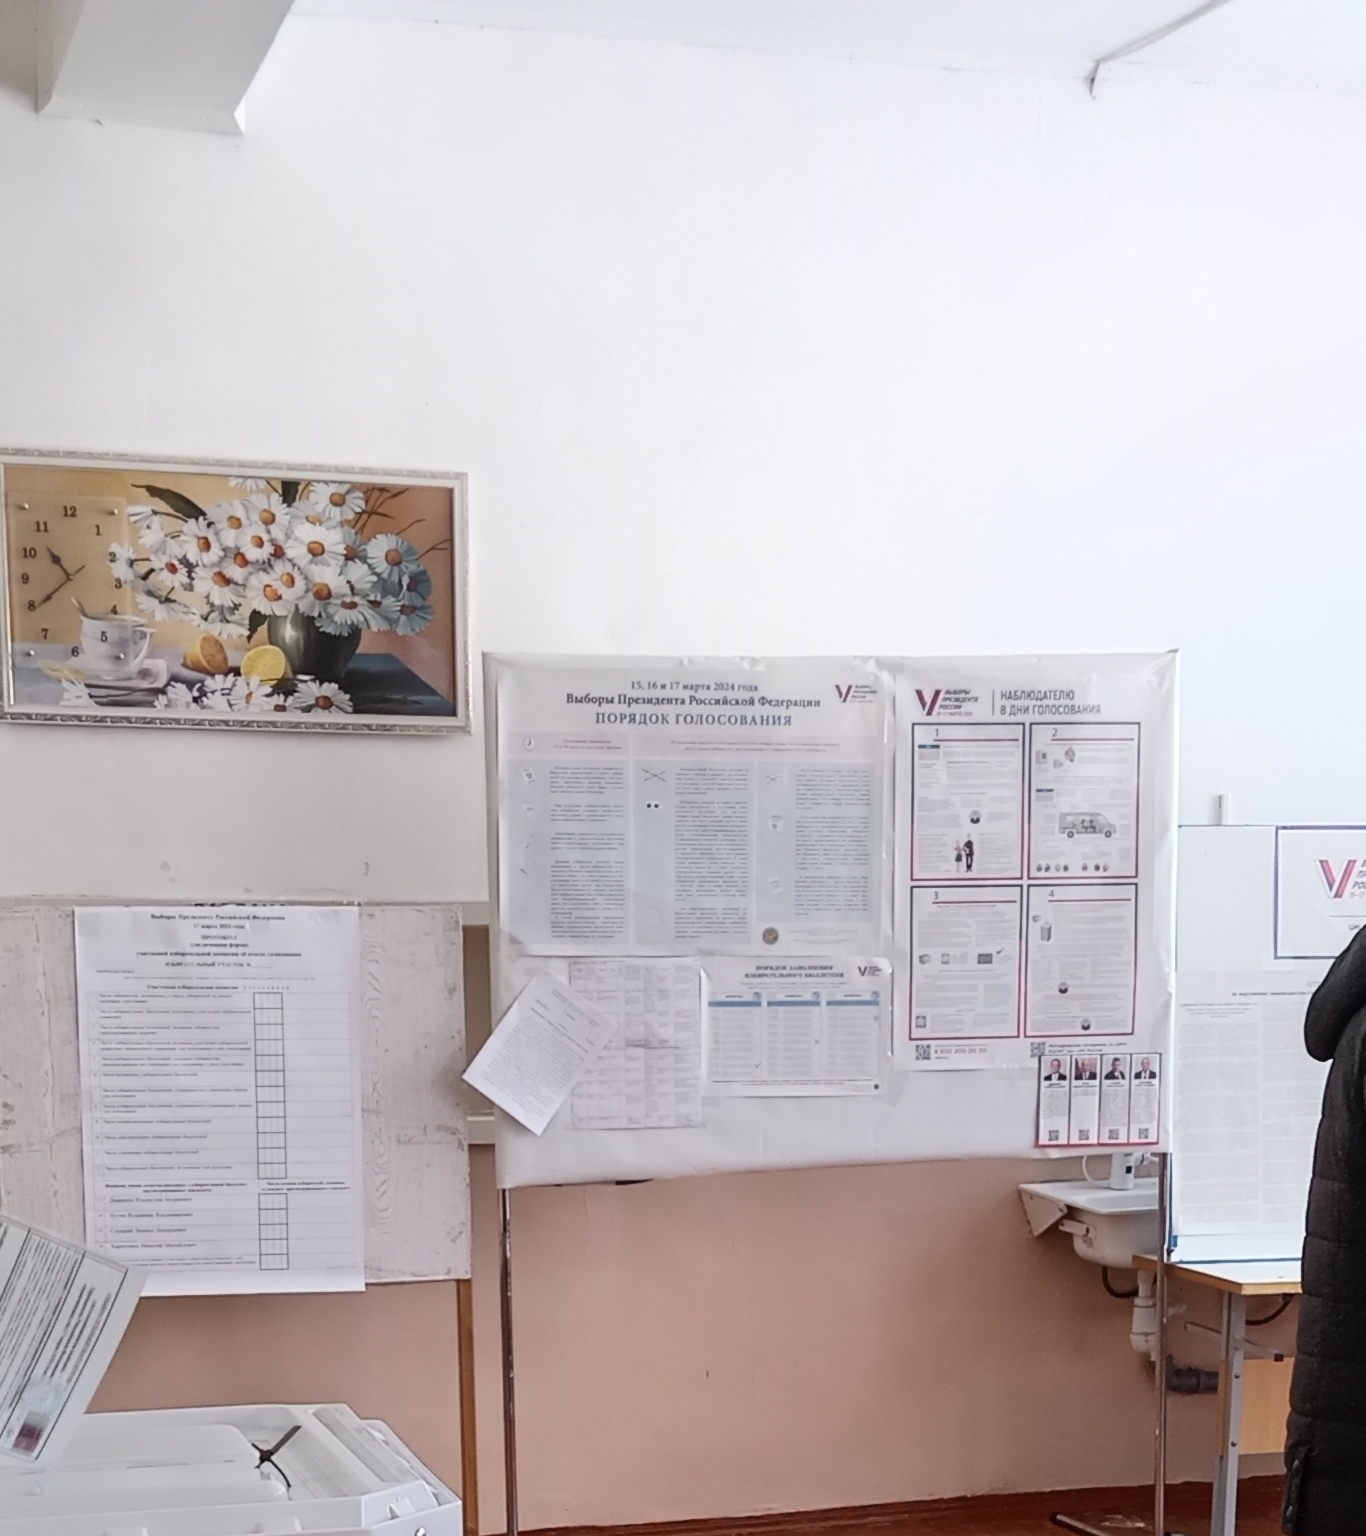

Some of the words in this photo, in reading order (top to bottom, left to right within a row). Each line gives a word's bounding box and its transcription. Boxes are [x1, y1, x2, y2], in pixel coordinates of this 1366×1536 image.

[62, 505, 77, 518] 12
[35, 521, 49, 533] 11
[95, 524, 101, 536] 1
[22, 547, 37, 559] 10
[109, 551, 117, 563] 2
[21, 573, 29, 584] 9
[114, 577, 122, 589] 3
[28, 600, 36, 611] 8
[110, 604, 118, 615] 4
[41, 628, 49, 639] 7
[100, 631, 108, 643] 5
[71, 646, 79, 657] 6
[630, 681, 645, 692] 15,
[647, 681, 658, 690] 16
[669, 681, 680, 691] 17
[682, 684, 711, 694] марта
[713, 682, 735, 692] 2024
[737, 684, 759, 694] года
[566, 693, 615, 706] Выборы
[617, 693, 686, 708] Президента
[688, 693, 756, 707] Российской
[757, 695, 821, 709] Федерации
[1000, 689, 1075, 701] НАБЛЮДАТЕЛЮ
[1000, 705, 1007, 715] В
[1008, 705, 1030, 717] ДНИ
[1032, 704, 1102, 715] ГОЛОСОВАНИЯ
[595, 712, 670, 727] ПОРЯДОК
[675, 713, 793, 727] ГОЛОСОВАНИЯ
[935, 728, 940, 737] 1
[1052, 728, 1058, 737] 2
[933, 891, 939, 900] 3
[1048, 890, 1055, 898] 4
